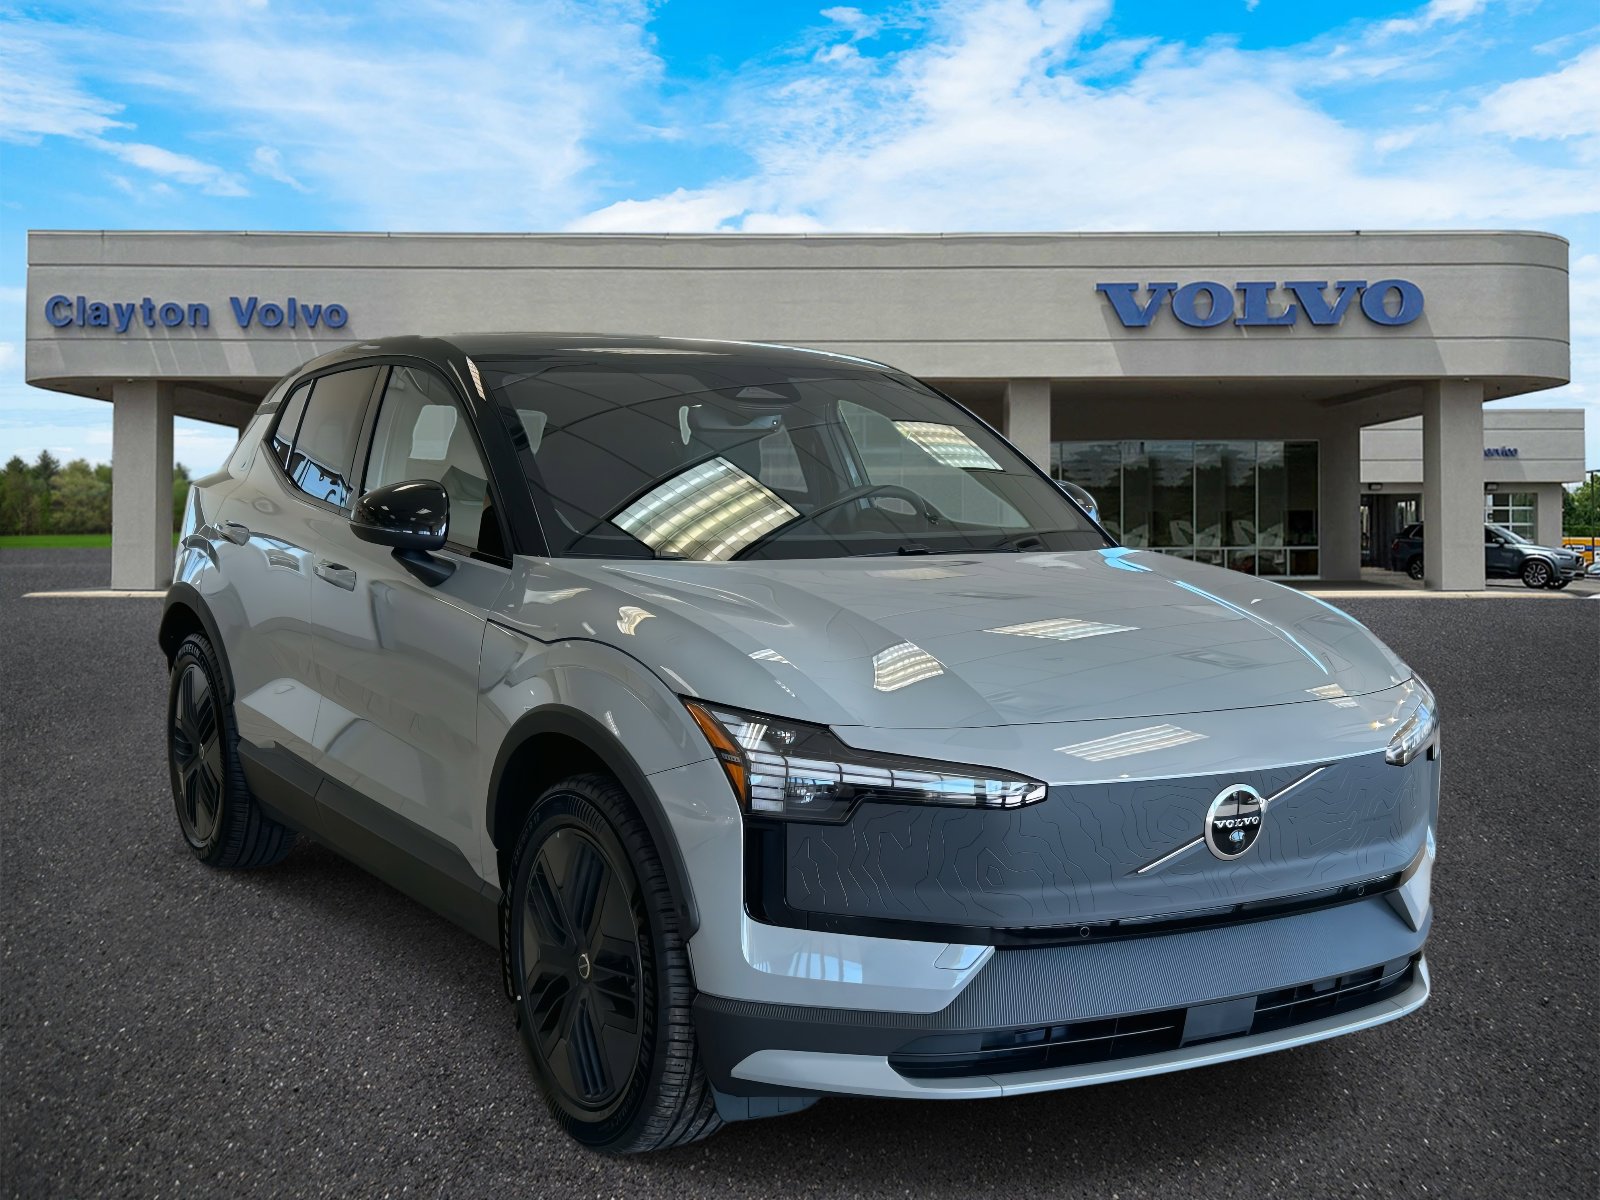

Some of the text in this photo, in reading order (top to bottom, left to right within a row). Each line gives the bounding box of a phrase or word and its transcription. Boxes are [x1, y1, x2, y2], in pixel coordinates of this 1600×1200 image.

[45, 295, 348, 333] Clayton Volvo
[1095, 279, 1425, 328] VOLVO
[1483, 446, 1518, 457] ervice
[1214, 816, 1260, 829] VOLVO
[638, 933, 656, 1071] MICHELIN
